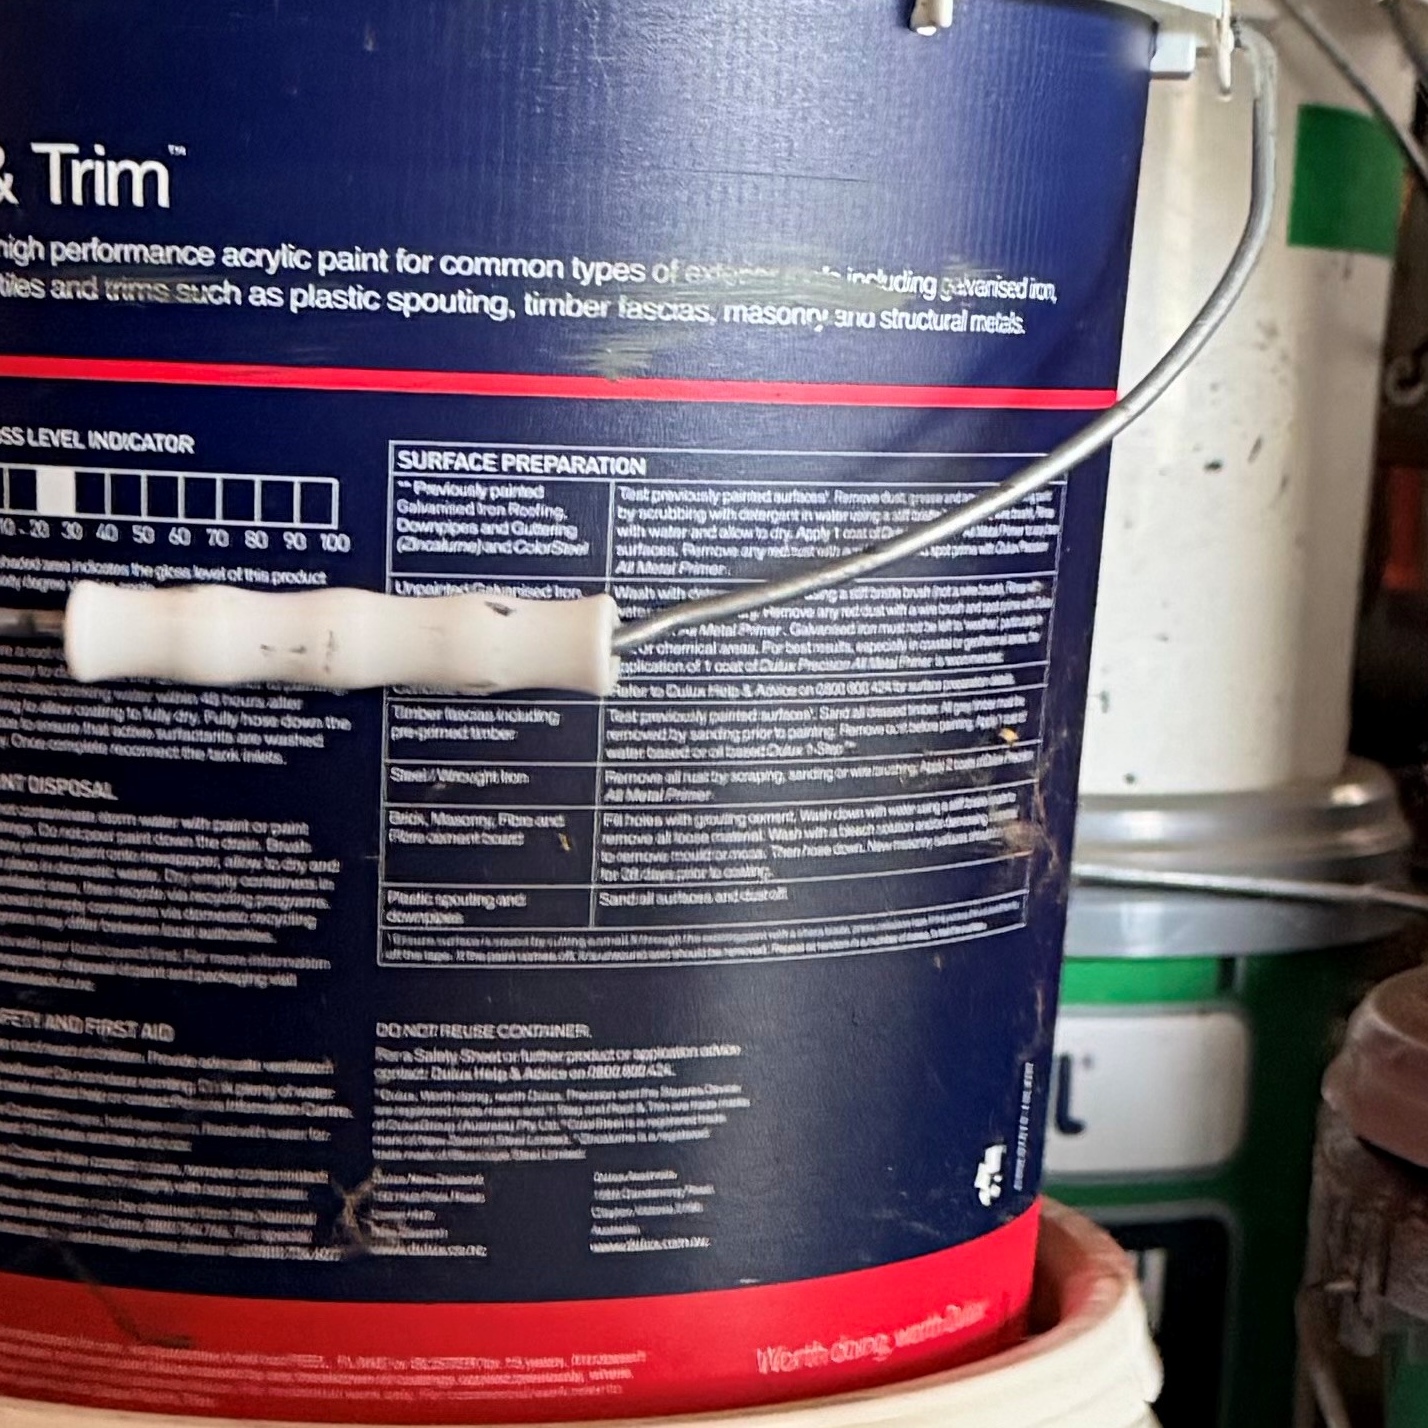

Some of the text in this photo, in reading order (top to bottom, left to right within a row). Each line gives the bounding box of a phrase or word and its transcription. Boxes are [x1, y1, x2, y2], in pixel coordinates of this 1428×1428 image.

[49, 236, 216, 268] performance
[221, 242, 313, 275] acrylic
[318, 244, 389, 277] paint
[395, 247, 435, 275] for
[439, 253, 565, 281] common
[571, 254, 647, 287] types
[651, 259, 682, 285] of
[940, 272, 1030, 303] galvanised
[49, 275, 100, 301] and
[103, 277, 171, 304] trims
[173, 278, 243, 307] such
[247, 284, 284, 308] as
[289, 283, 382, 315] plastic
[386, 287, 517, 322] spouting,
[523, 290, 613, 319] timber
[617, 295, 718, 326] fascias,
[723, 303, 829, 333] masonry
[878, 309, 968, 333] structural
[968, 311, 1027, 336] metals.
[26, 427, 86, 451] LEVEL
[87, 429, 196, 456] INDICATOR
[396, 449, 647, 478] SURFACE PREPARATION
[412, 479, 546, 501] Previously painted
[60, 520, 84, 541] 30
[95, 522, 120, 543] 40
[131, 523, 157, 545] 50
[168, 525, 193, 547] 60
[205, 527, 231, 549] 70
[244, 529, 270, 550] 80
[282, 531, 309, 552] 90
[319, 531, 352, 553] 100
[396, 517, 479, 538] Downpipes
[479, 519, 510, 536] and
[756, 1340, 829, 1375] Worth
